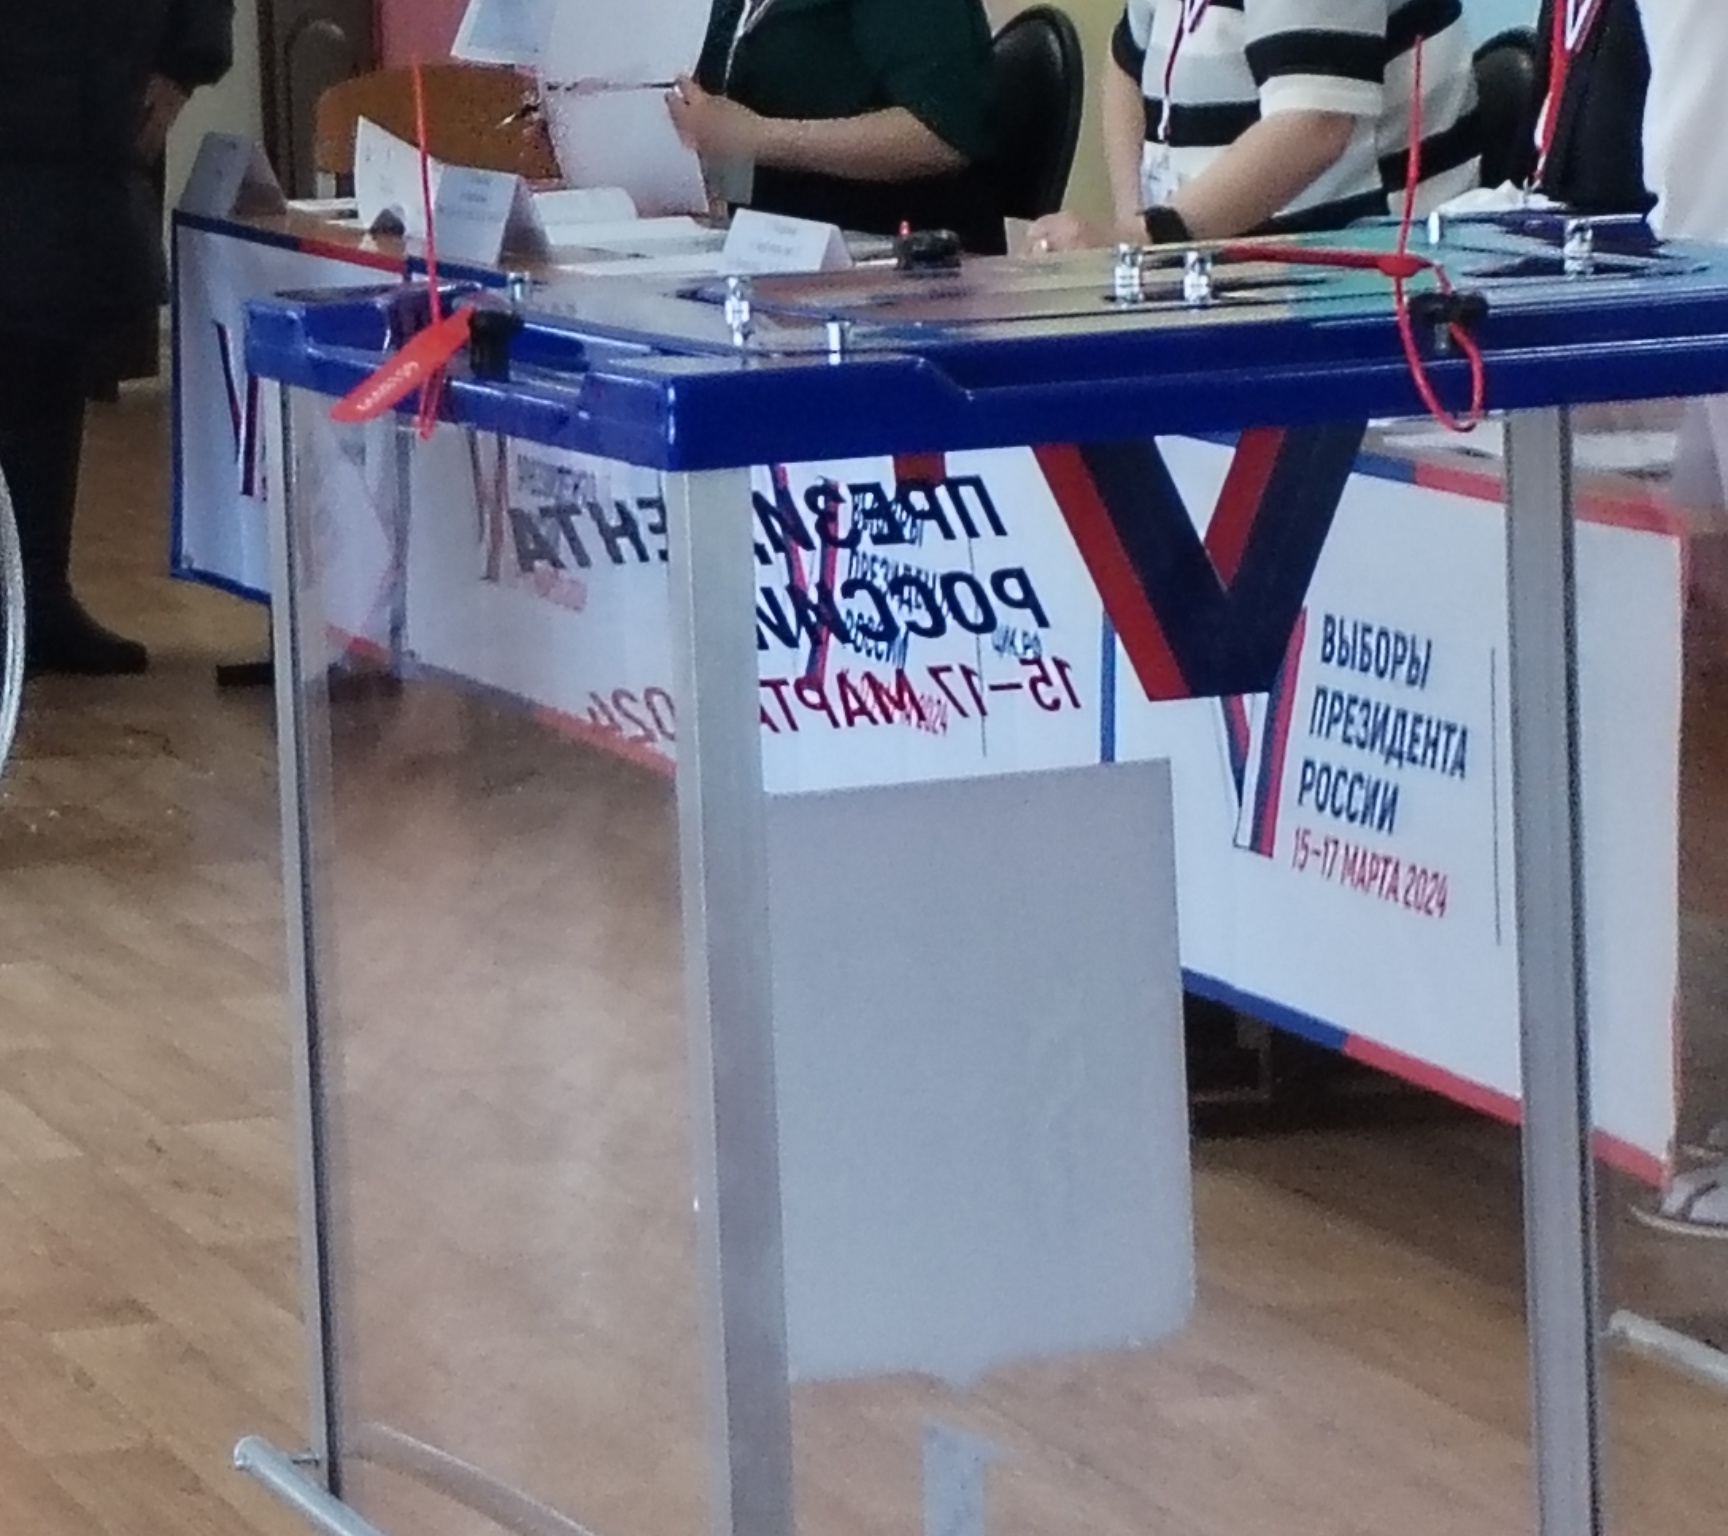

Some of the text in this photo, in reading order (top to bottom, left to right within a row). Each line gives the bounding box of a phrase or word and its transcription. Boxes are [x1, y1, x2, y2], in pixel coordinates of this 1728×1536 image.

[1321, 614, 1432, 690] ВЫБОРЫ
[1309, 685, 1469, 779] ПРЕЗИДЕНТА
[1297, 759, 1399, 836] РОССИИ
[1340, 843, 1399, 906] МАРТА
[1403, 865, 1449, 918] 2024
